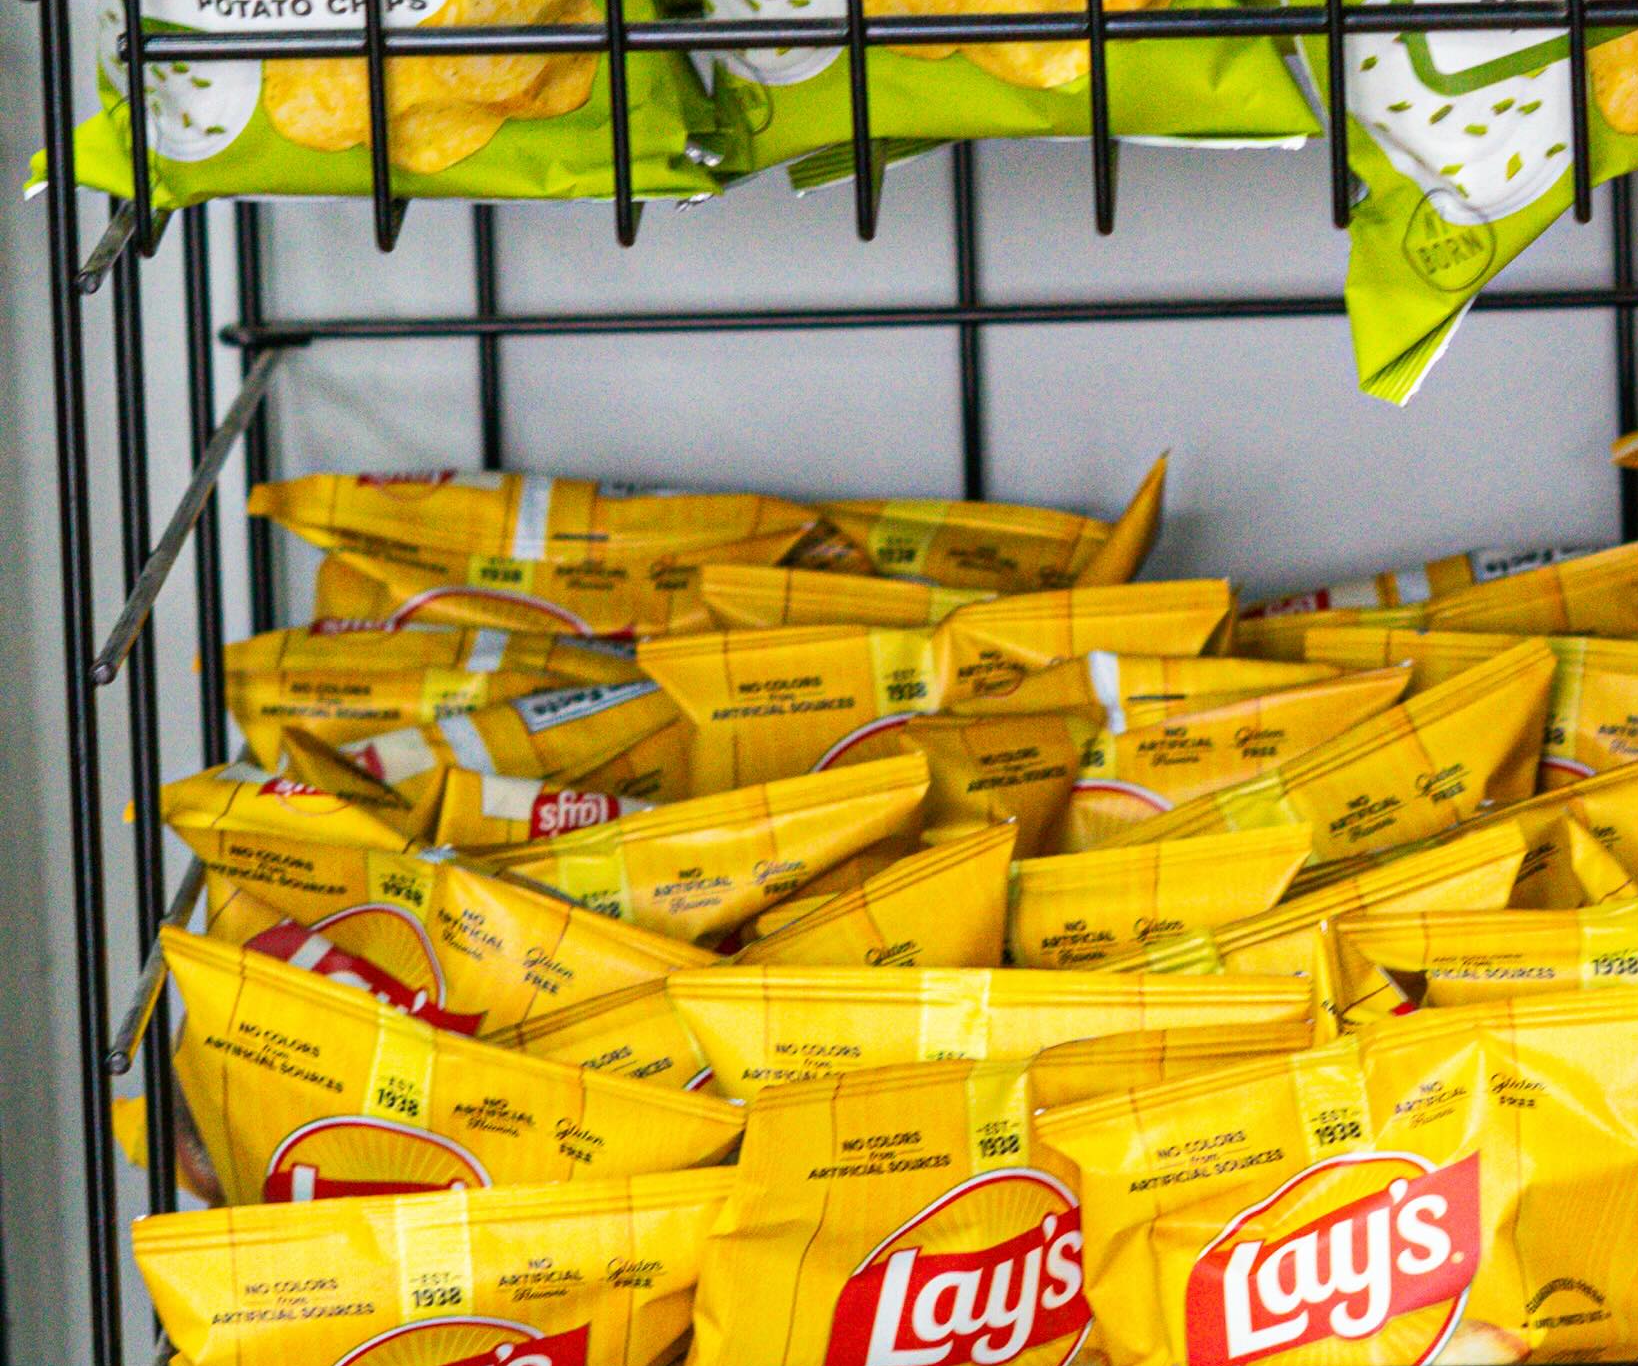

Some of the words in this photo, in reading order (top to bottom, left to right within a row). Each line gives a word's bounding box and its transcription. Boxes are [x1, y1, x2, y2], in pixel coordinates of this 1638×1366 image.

[869, 1130, 923, 1151] COLORS
[1314, 1121, 1362, 1146] 1938
[978, 1134, 1021, 1158] 1938
[807, 1161, 886, 1181] ARTIFICIAL
[888, 1154, 952, 1175] SOURCES
[1224, 1179, 1453, 1360] Lay's
[411, 1286, 463, 1308] 1938
